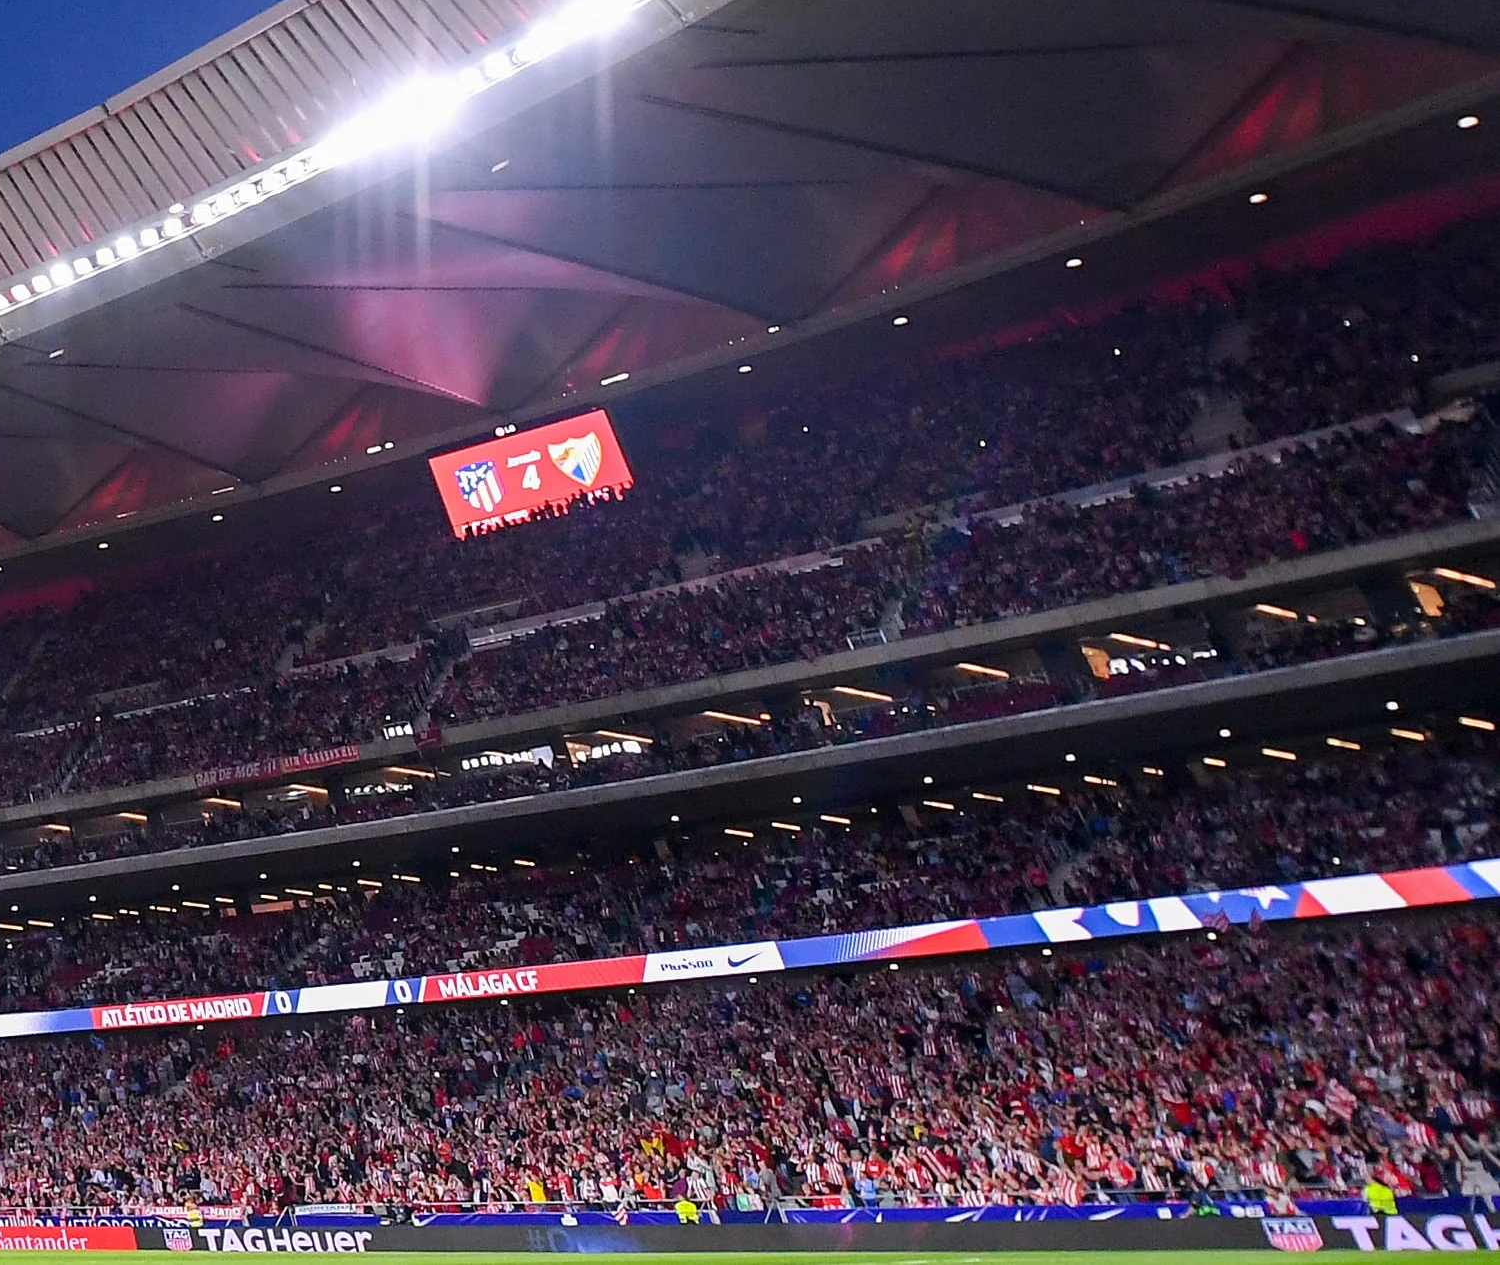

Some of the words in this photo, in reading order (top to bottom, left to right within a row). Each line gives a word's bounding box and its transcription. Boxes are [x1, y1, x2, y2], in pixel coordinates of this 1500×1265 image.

[522, 464, 541, 490] 4
[217, 769, 233, 782] DE
[660, 958, 714, 972] Plus500
[393, 981, 411, 1003] 0
[438, 972, 518, 999] MÁLAGA
[515, 970, 540, 991] CF
[101, 1003, 168, 1028] ATLÉTICO
[167, 1004, 189, 1022] DE
[190, 998, 253, 1021] MADRID
[275, 991, 293, 1014] 0
[1266, 1220, 1313, 1234] TAG
[166, 1230, 188, 1239] TAG
